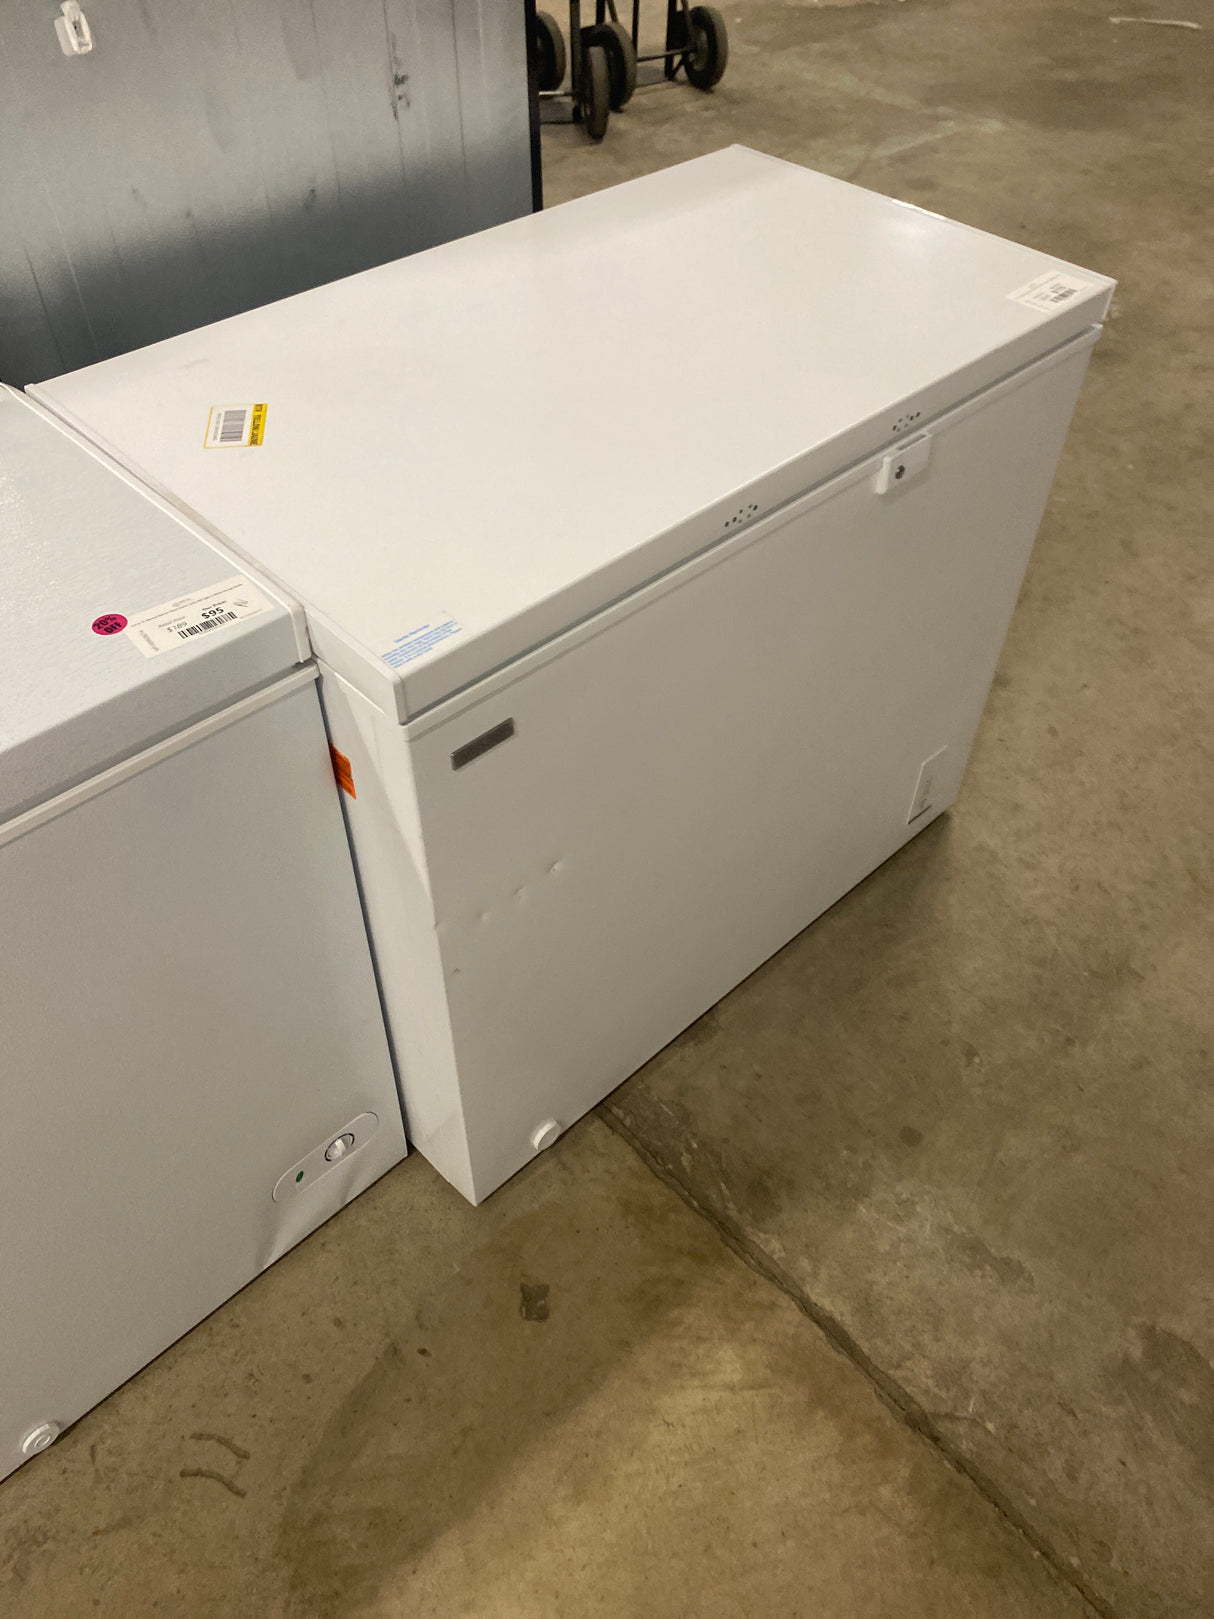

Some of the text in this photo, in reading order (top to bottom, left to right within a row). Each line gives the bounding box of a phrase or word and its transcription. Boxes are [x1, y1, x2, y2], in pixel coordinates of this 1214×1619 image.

[201, 607, 224, 619] $95
[93, 616, 117, 629] 20%
[104, 622, 122, 634] OFF
